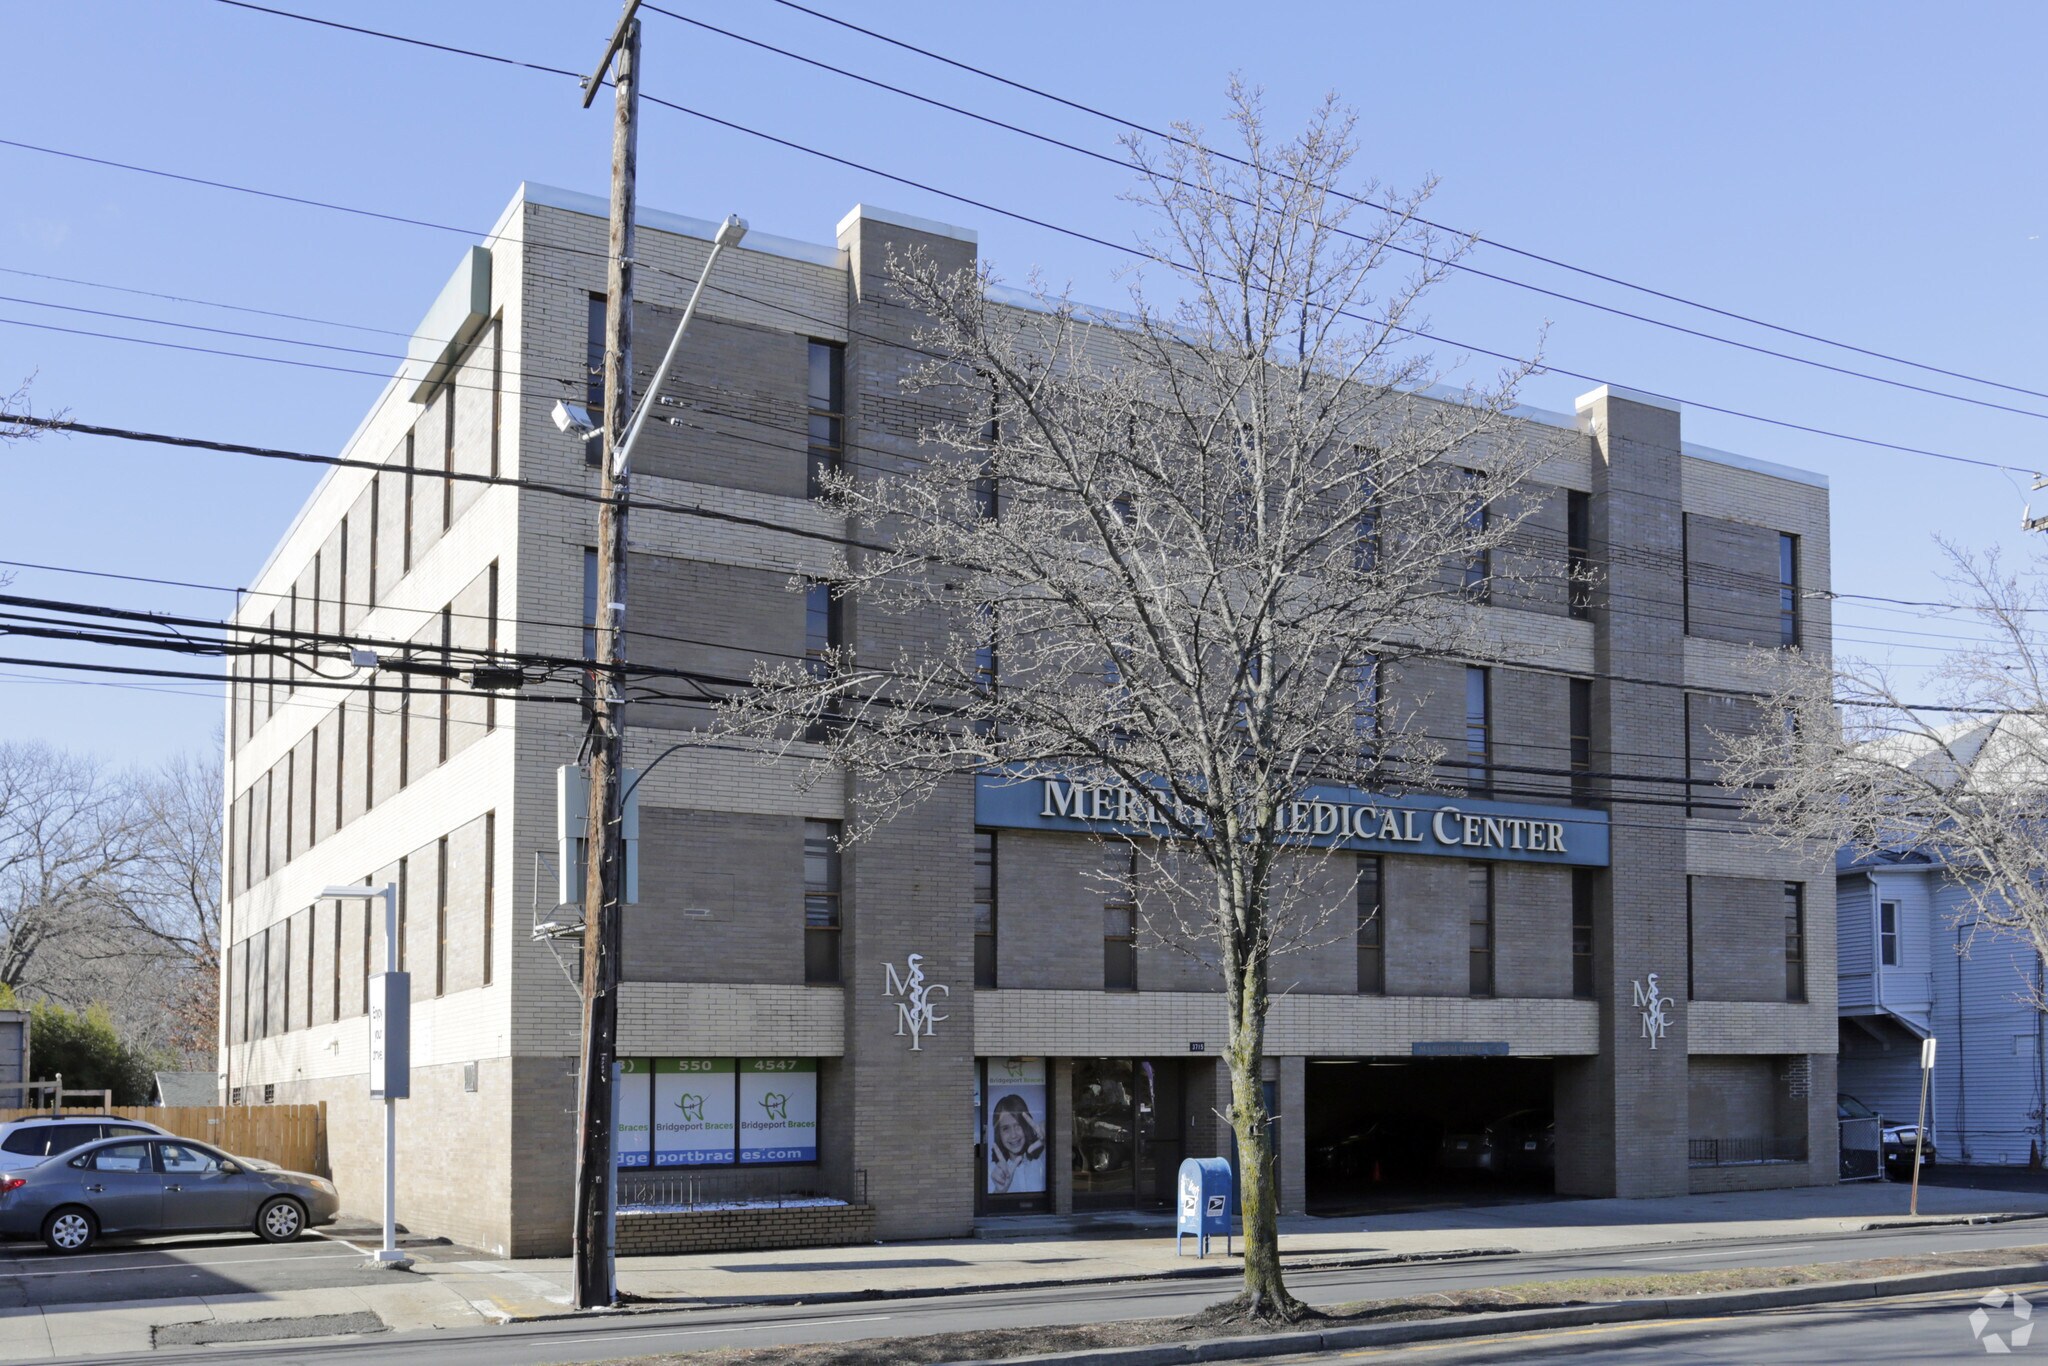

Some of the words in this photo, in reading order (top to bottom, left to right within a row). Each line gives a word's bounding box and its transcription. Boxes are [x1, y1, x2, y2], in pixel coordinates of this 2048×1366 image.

[1432, 806, 1568, 853] CENTER
[679, 1061, 712, 1071] 550
[754, 1060, 797, 1070] 4547
[618, 1123, 649, 1132] Braces
[656, 1122, 703, 1132] Bridgeport
[704, 1122, 734, 1130] Braces
[741, 1121, 787, 1131] Bridgeport
[788, 1120, 816, 1129] Braces
[656, 1151, 735, 1164] portbrac
[741, 1149, 802, 1160] es.com
